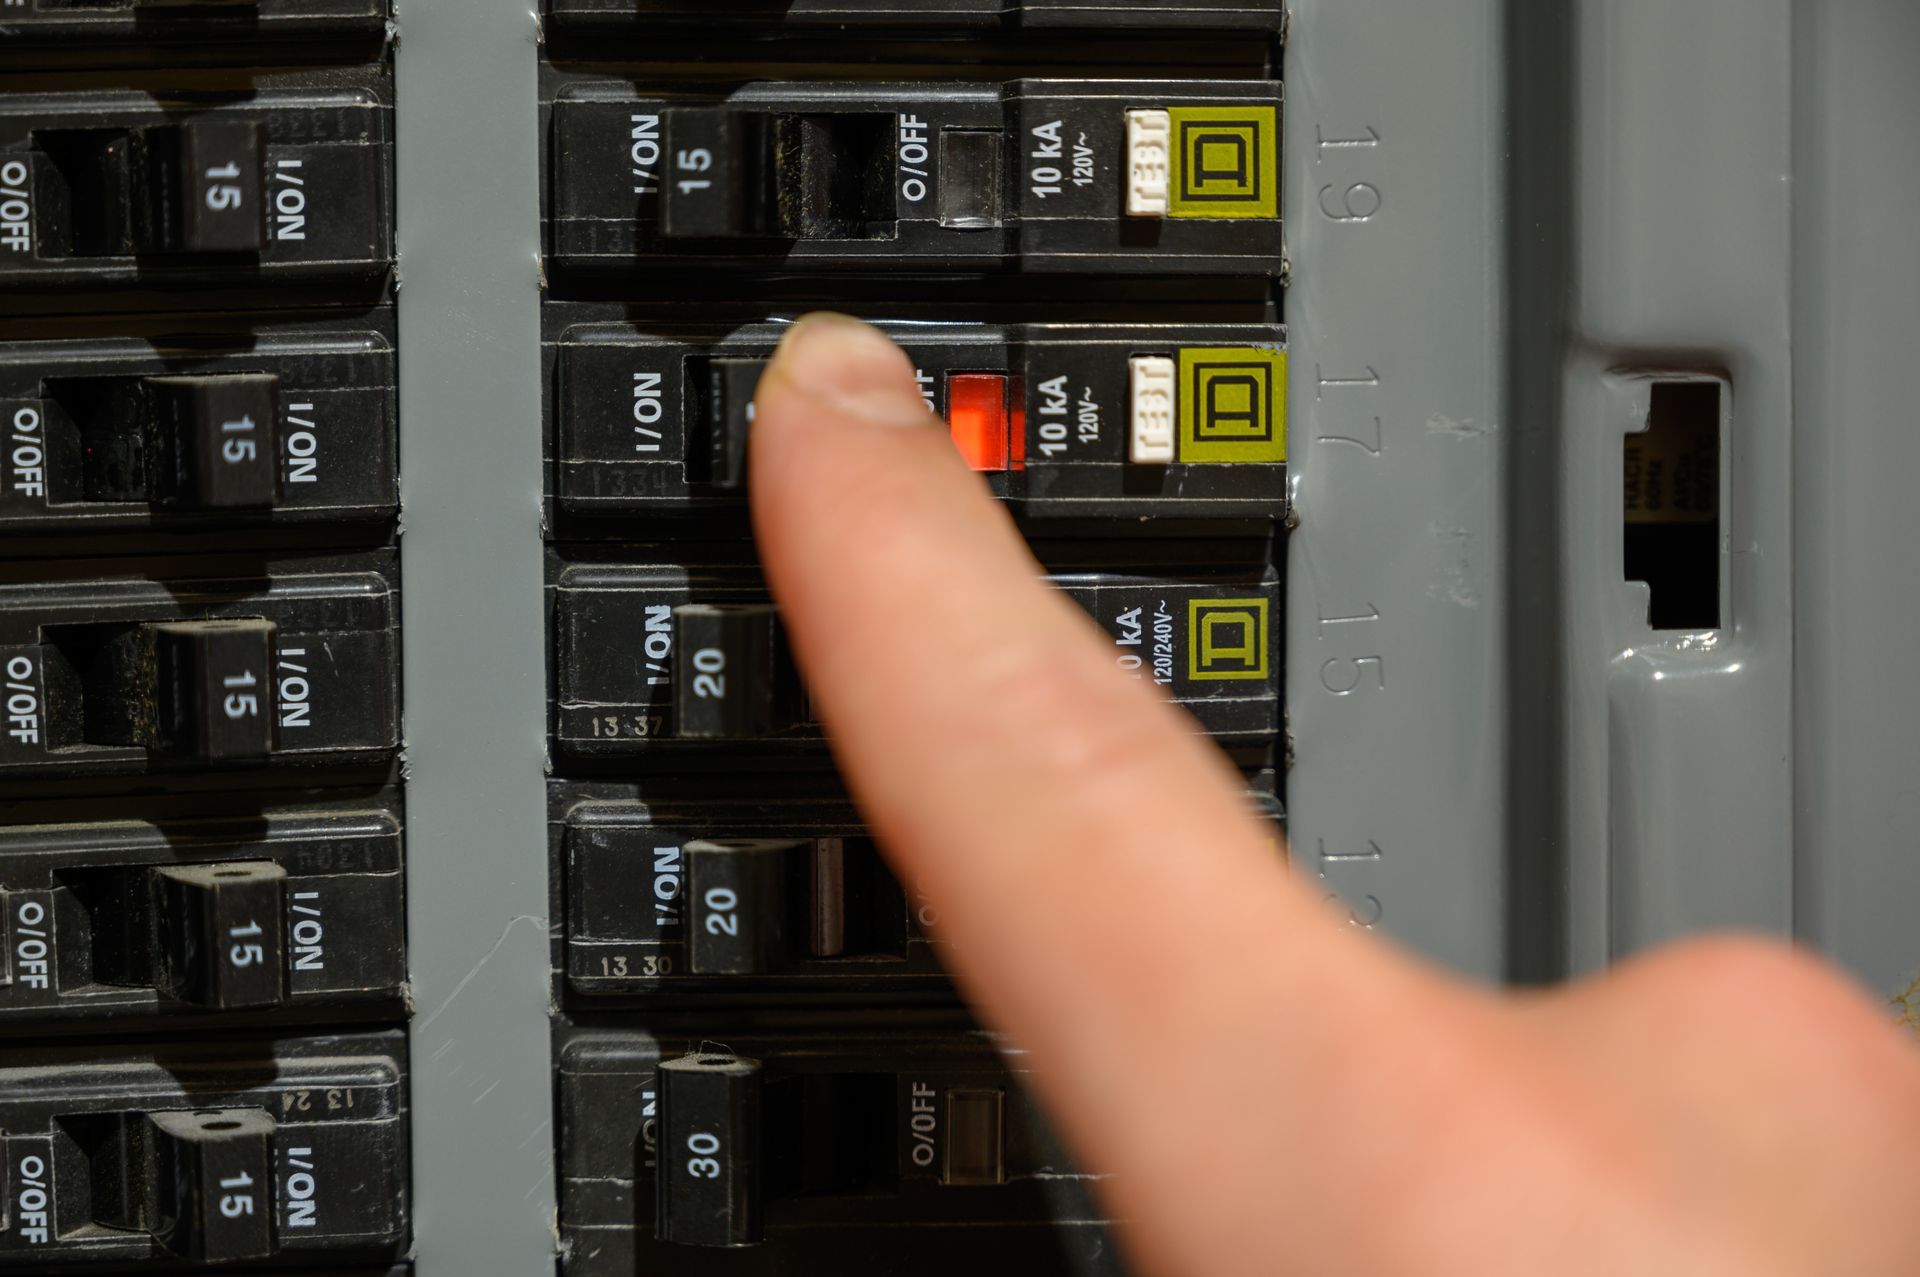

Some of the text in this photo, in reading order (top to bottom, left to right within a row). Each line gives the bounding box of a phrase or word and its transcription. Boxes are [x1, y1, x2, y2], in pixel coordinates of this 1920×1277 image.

[207, 163, 241, 209] 15
[631, 115, 659, 193] I/ON
[678, 149, 711, 194] 15
[900, 114, 928, 201] O/OFF
[1032, 120, 1062, 198] 10 kA
[1135, 115, 1167, 198] TEST
[1316, 123, 1382, 223] 19
[0, 162, 29, 251] O/OFF
[276, 160, 305, 239] I/ON
[222, 416, 256, 462] 15
[288, 404, 317, 482] I/ON
[634, 373, 662, 451] I/ON
[1039, 376, 1067, 456] 10 kA
[1138, 364, 1170, 447] TEST
[1316, 362, 1381, 457] 17
[12, 408, 42, 496] O/OFF
[645, 605, 671, 684] I/ON
[1116, 607, 1141, 644] kA
[1318, 601, 1385, 696] 15
[7, 657, 38, 744] O/OFF
[224, 671, 257, 717] 15
[280, 649, 310, 727] I/ON
[693, 649, 723, 697] 20
[592, 716, 663, 737] 13 37
[654, 847, 680, 925] I/ON
[705, 888, 737, 935] 20
[18, 902, 48, 988] O/OFF
[231, 921, 263, 966] 15
[293, 892, 323, 970] I/ON
[601, 956, 673, 976] 13 30
[282, 1089, 354, 1110] 13 24
[911, 1082, 935, 1165] O/OFF
[220, 1172, 253, 1217] 15
[287, 1148, 316, 1227] I/ON
[688, 1133, 719, 1178] 30
[20, 1156, 47, 1243] O/OFF
